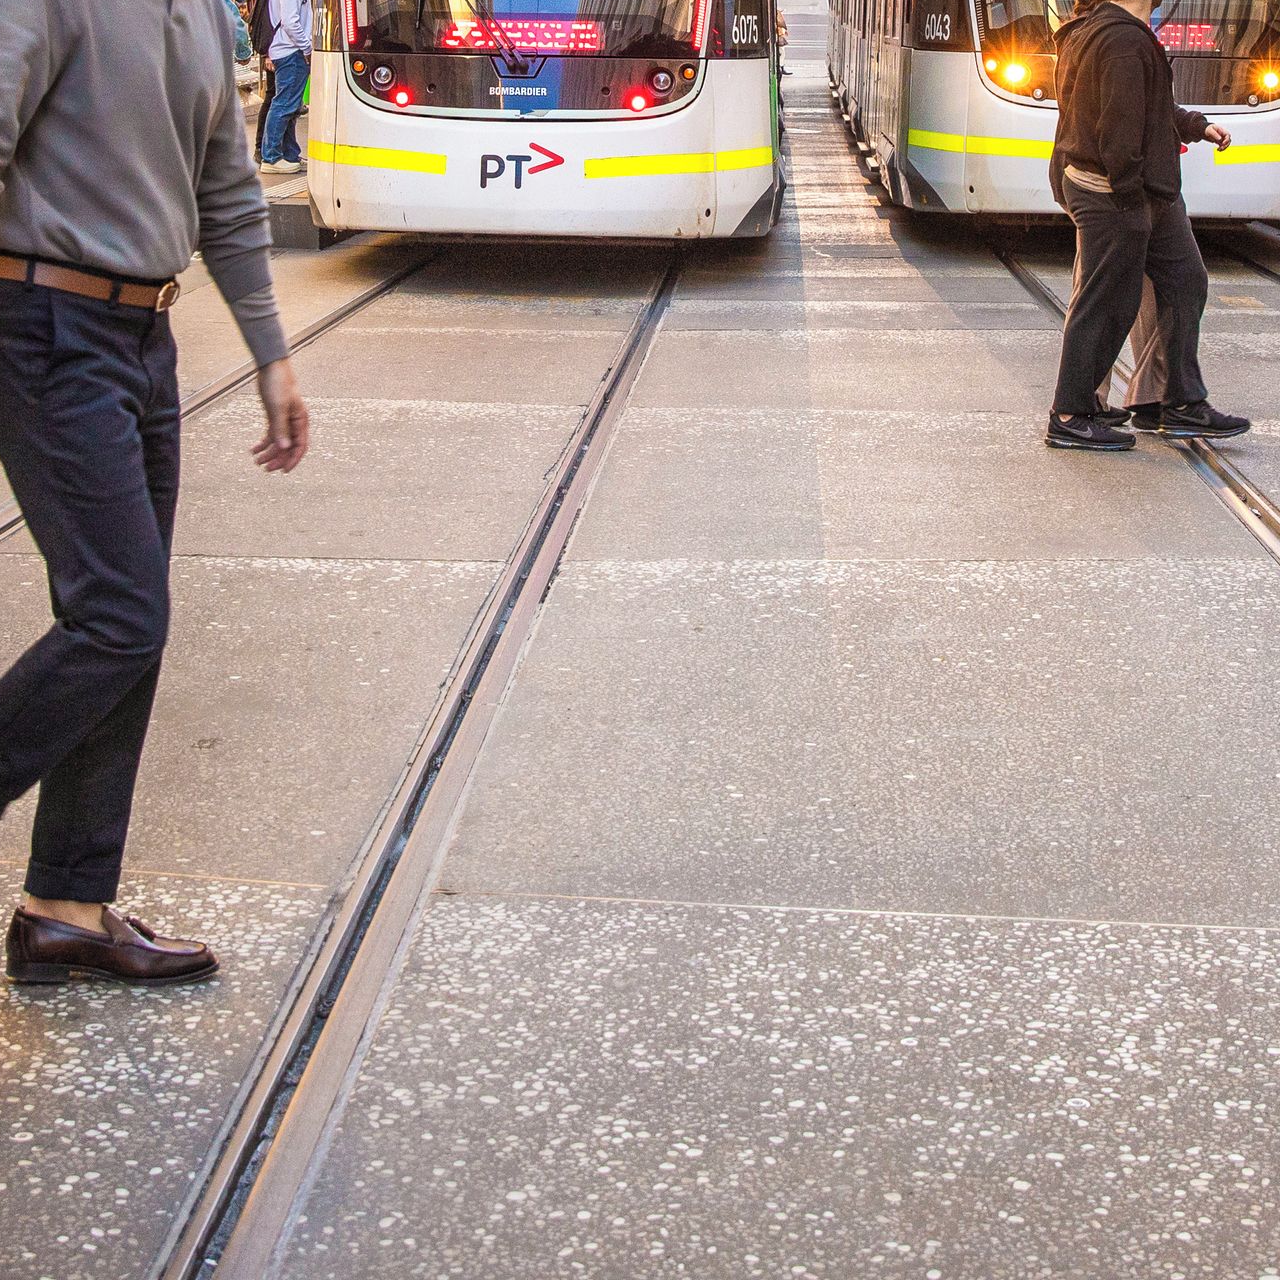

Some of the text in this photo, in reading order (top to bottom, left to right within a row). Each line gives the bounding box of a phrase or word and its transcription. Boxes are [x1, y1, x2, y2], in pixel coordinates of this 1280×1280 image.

[732, 14, 758, 44] 6075
[925, 13, 950, 41] 6043
[489, 86, 547, 97] BOMBARDIER
